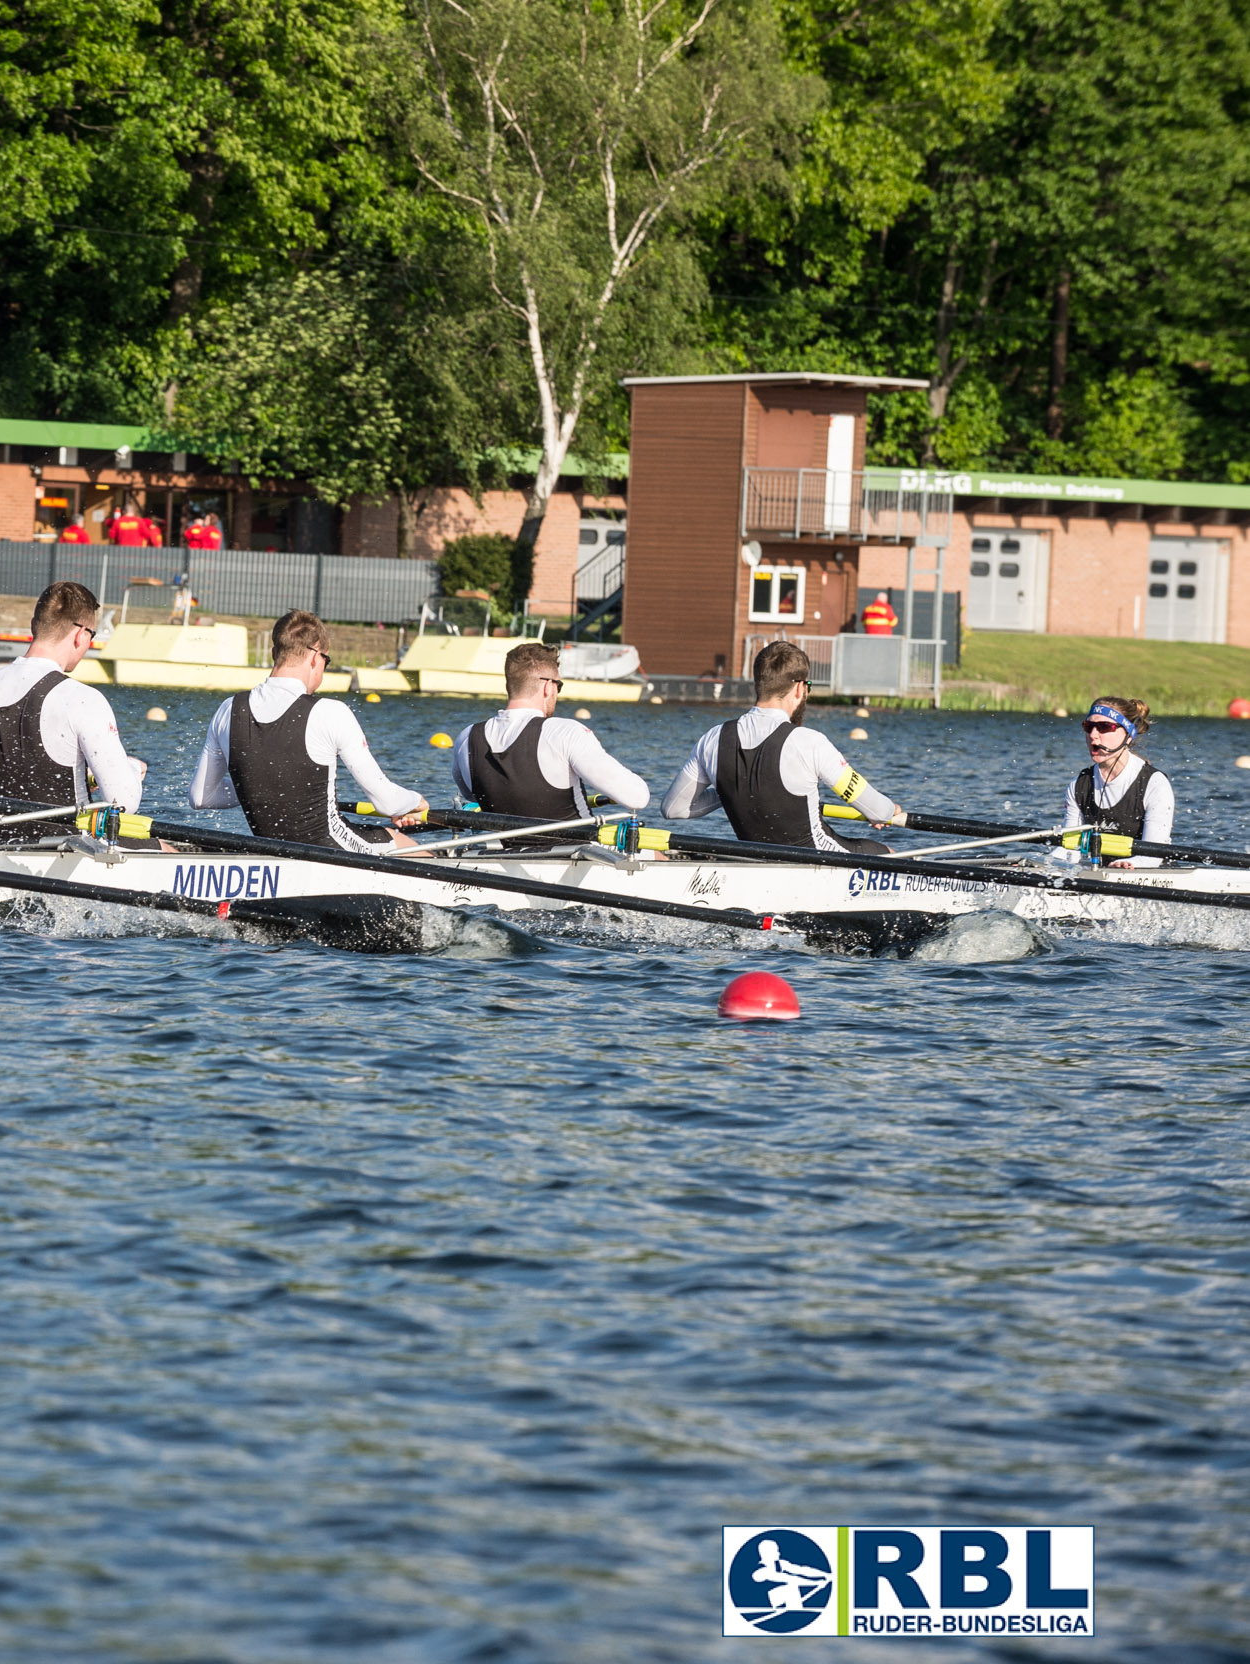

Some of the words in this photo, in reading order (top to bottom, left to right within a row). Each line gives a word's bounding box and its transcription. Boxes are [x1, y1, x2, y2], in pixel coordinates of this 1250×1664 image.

[900, 469, 972, 494] DLRG
[980, 479, 1062, 496] Regattabahn
[1065, 483, 1124, 500] Duisburg
[172, 864, 280, 899] MINDEN
[866, 870, 901, 891] RBL
[904, 875, 1010, 892] RUDER-BUNDESA
